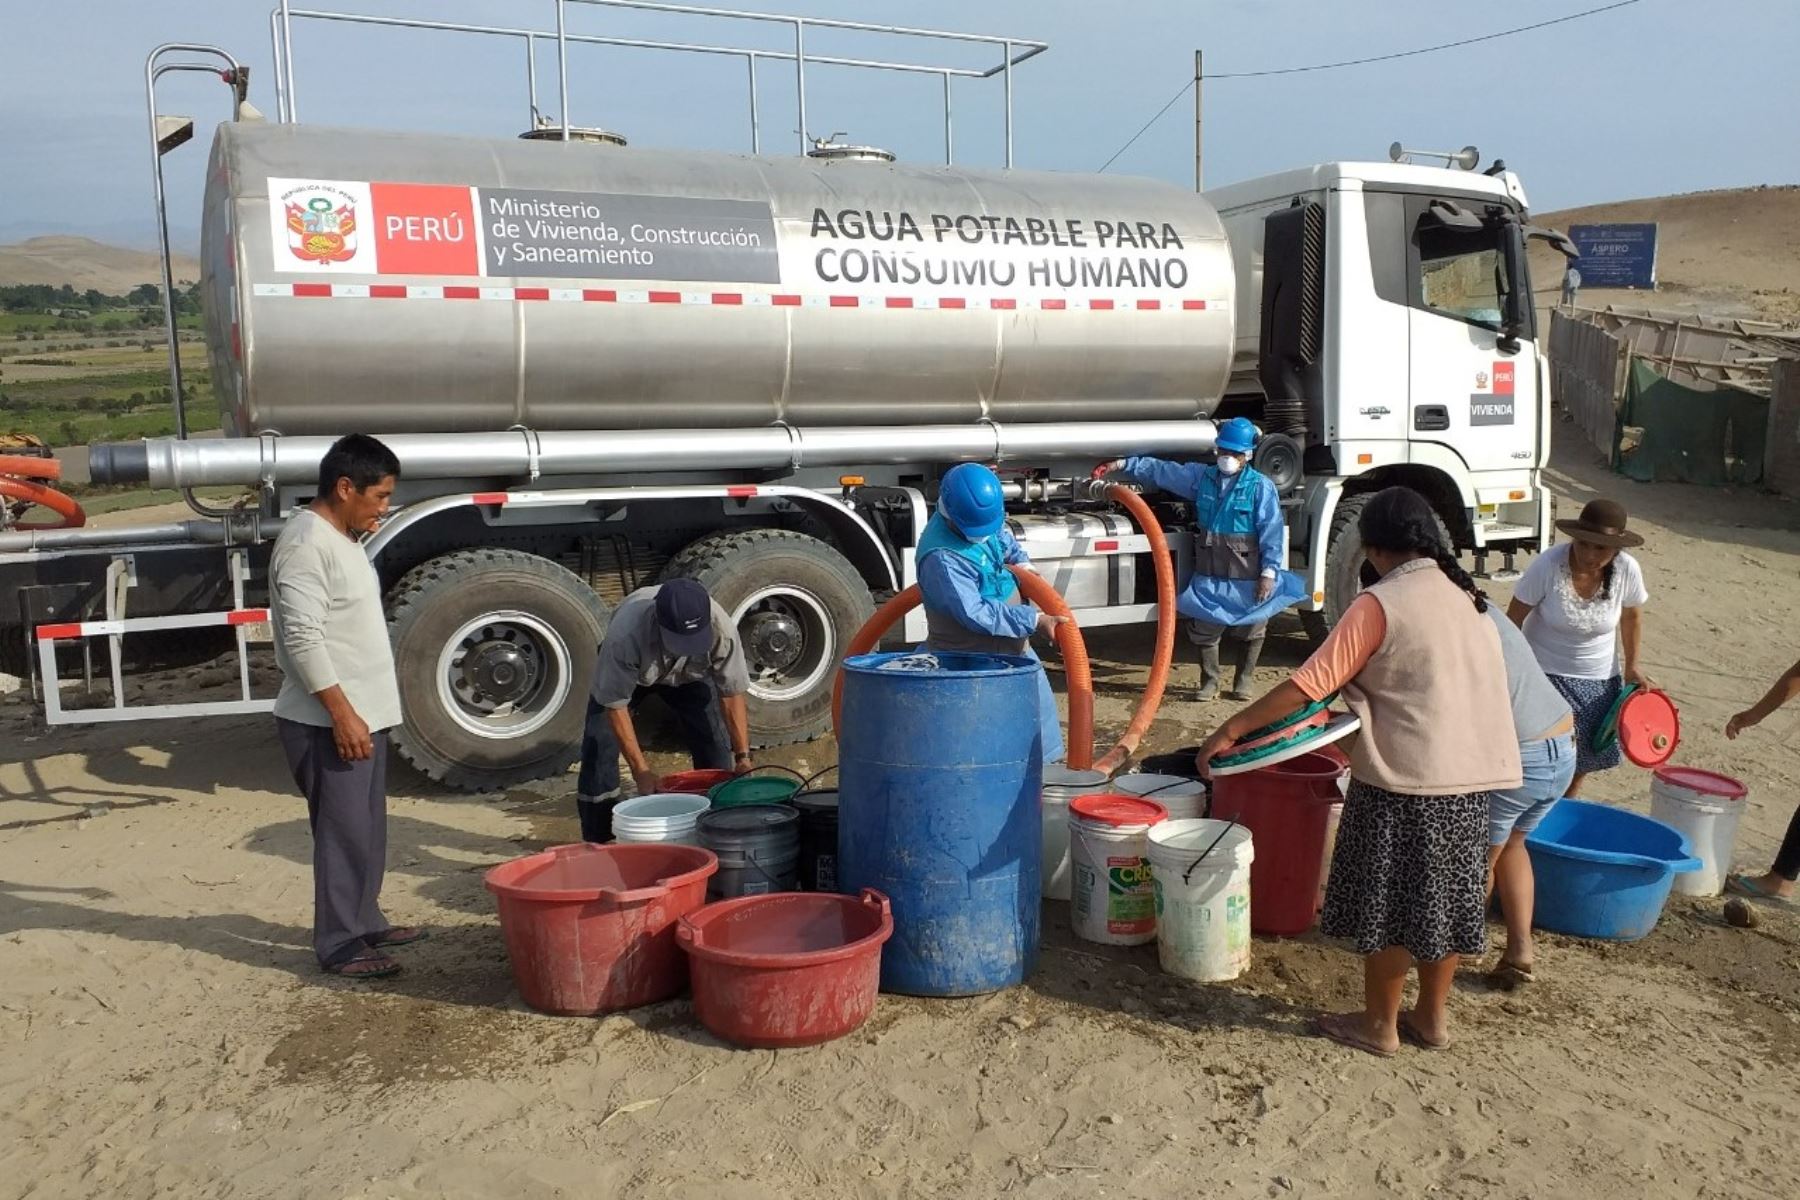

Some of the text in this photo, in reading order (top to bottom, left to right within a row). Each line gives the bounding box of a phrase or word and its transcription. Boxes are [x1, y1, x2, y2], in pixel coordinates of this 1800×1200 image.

[490, 198, 600, 220] Ministerio
[386, 212, 464, 242] PERÚ
[492, 218, 761, 247] de Vivienda, Construcción
[810, 207, 1185, 250] AGUA POTABLE PARA
[493, 242, 654, 266] y Saneamiento
[815, 247, 1189, 289] CONSUMO HUMANO
[1471, 404, 1513, 416] VIVIENDA
